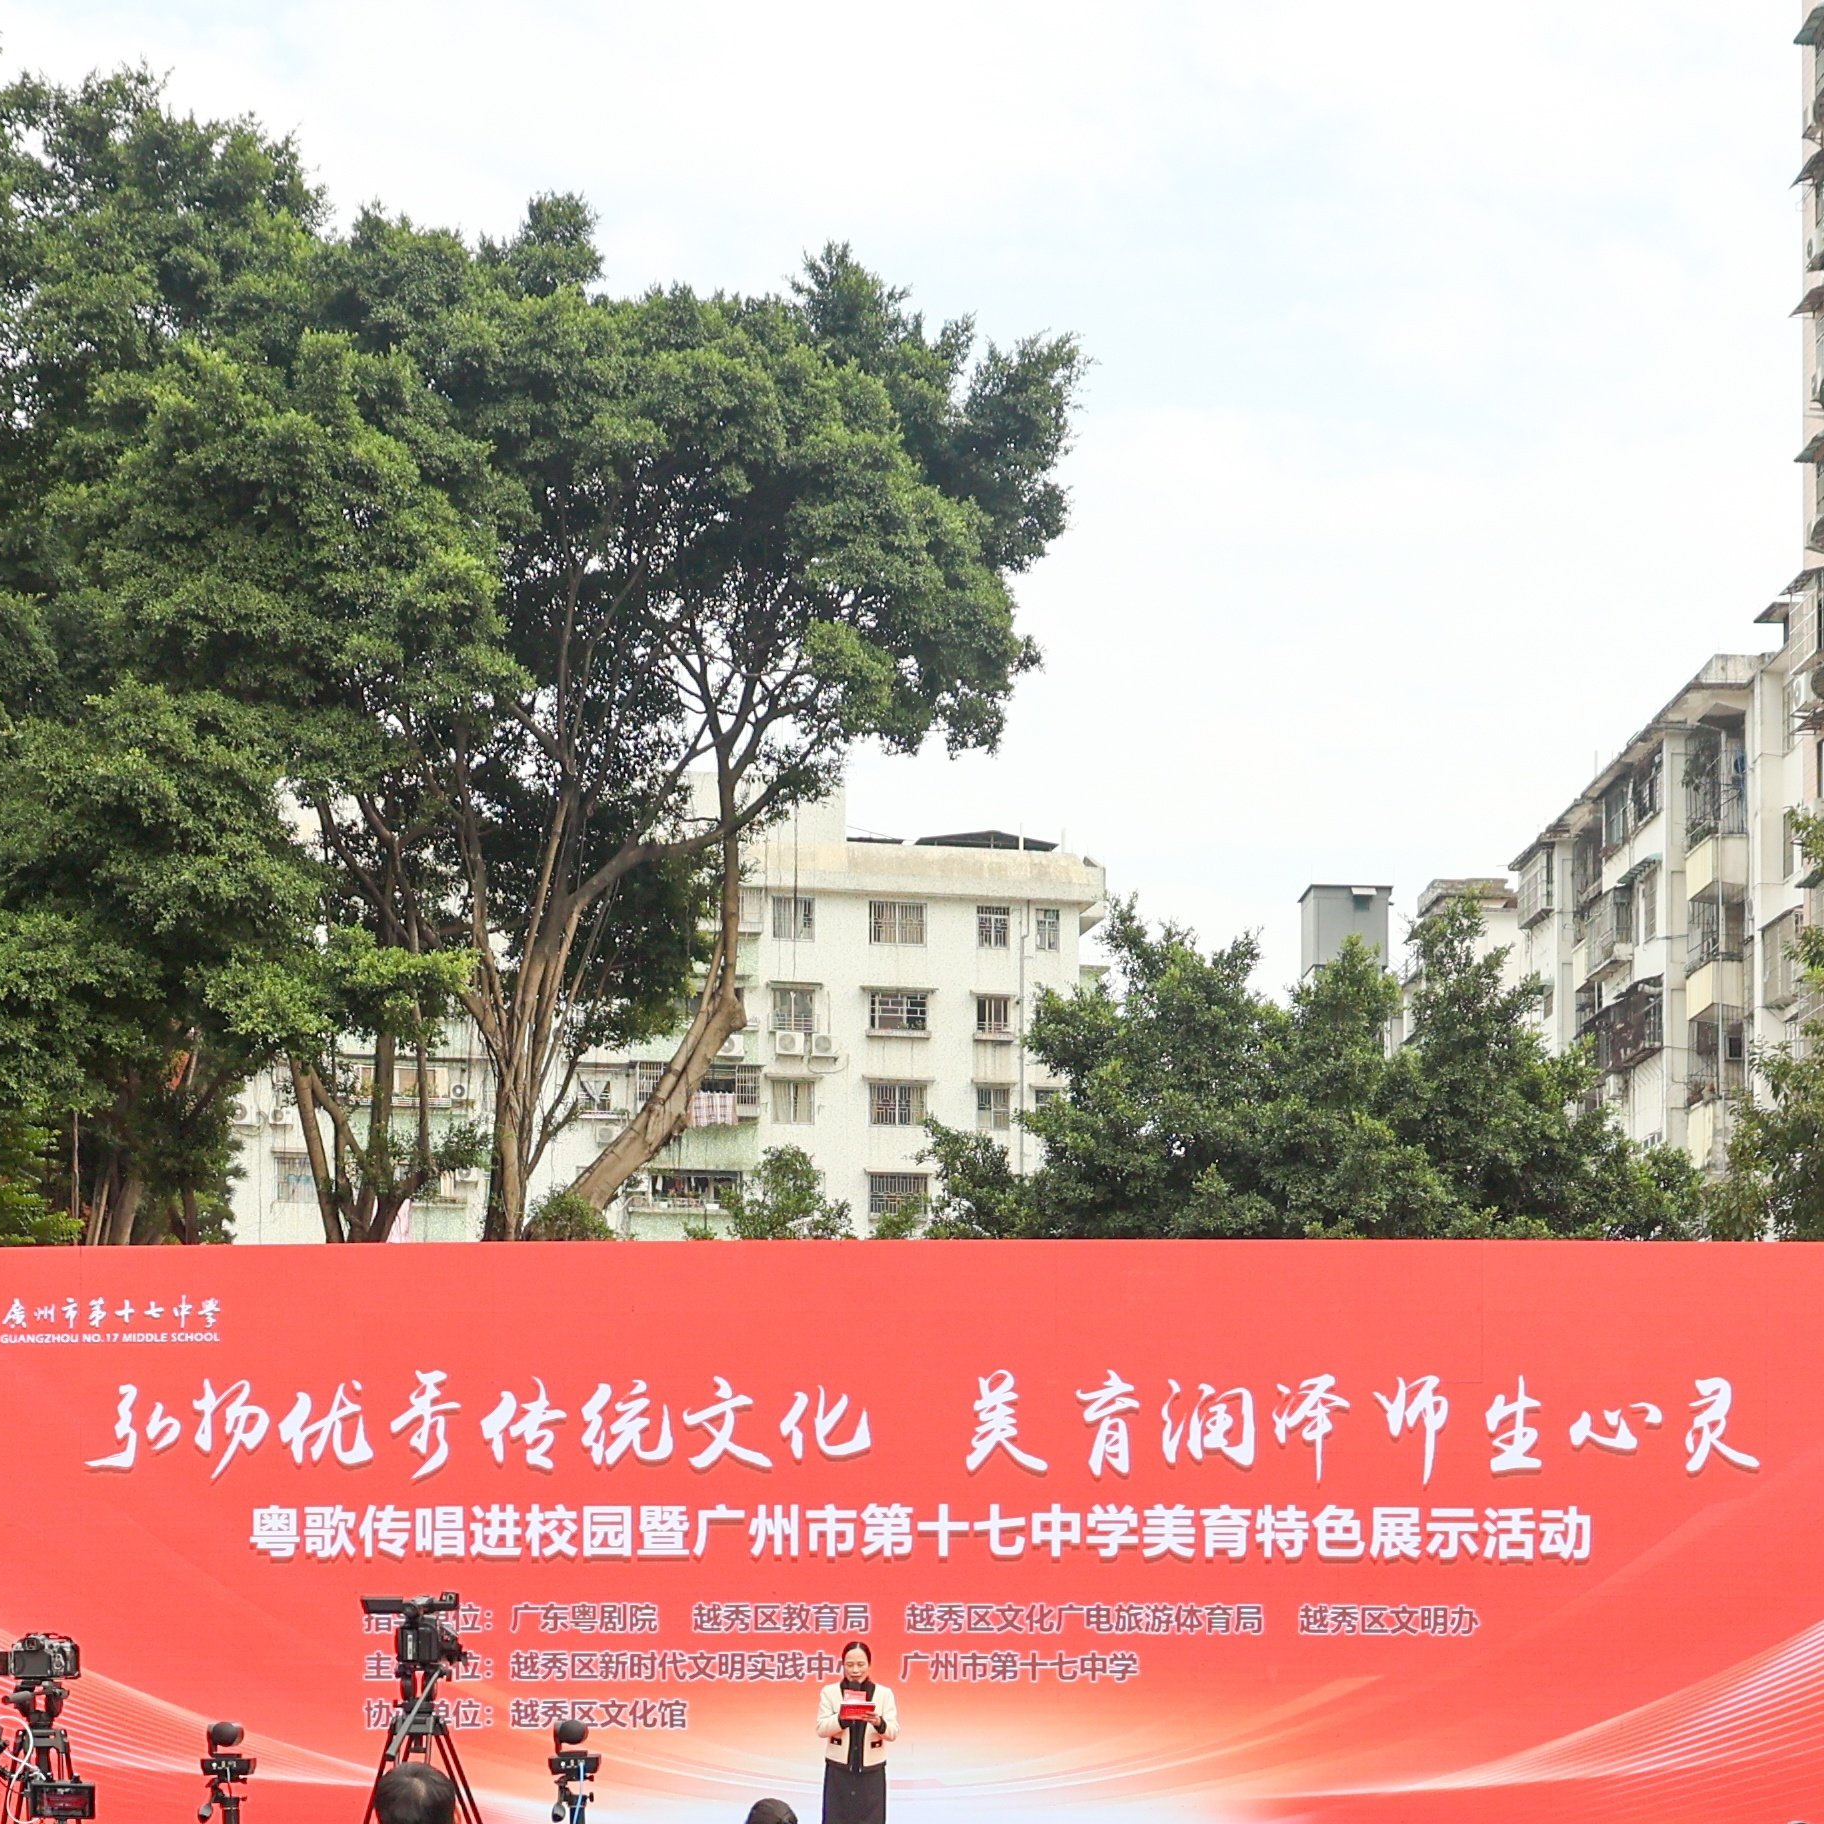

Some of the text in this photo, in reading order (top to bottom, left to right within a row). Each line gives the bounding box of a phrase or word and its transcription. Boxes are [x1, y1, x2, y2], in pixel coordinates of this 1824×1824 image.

[0, 1332, 221, 1344] GUANGZHOU NO.17 MIDDLE SCHOOL
[84, 1369, 1760, 1485] 弘扬优秀传统文化 美育润泽师生心灵
[249, 1503, 1591, 1560] 粤歌传唱进校园暨广州市第十七中学美育特色展示活动
[693, 1602, 870, 1634] 越秀区教育局
[906, 1602, 1263, 1635] 越秀区文化广电旅游体育局
[1299, 1604, 1480, 1636] 越秀区文明办
[901, 1651, 1139, 1682] 广州市第十七中学
